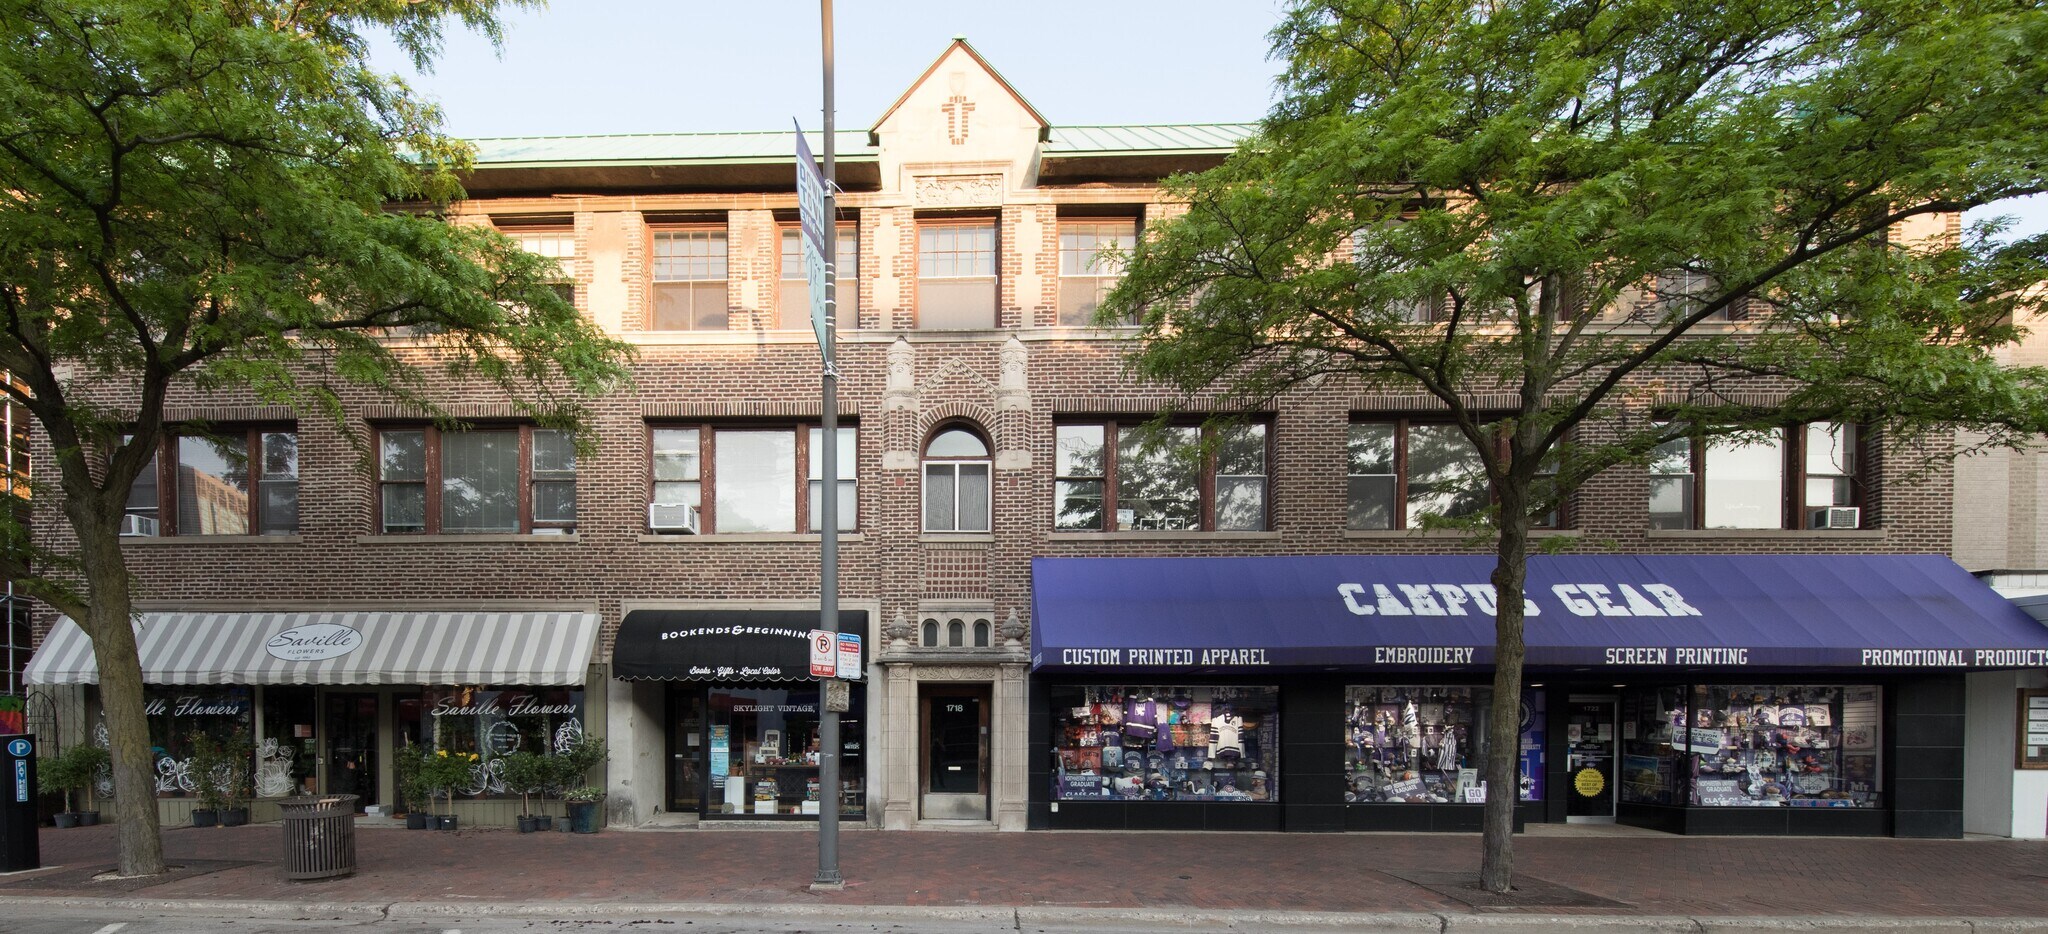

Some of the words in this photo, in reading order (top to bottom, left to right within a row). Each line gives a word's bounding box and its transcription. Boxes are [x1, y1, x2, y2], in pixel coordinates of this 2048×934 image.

[1551, 583, 1703, 617] GEAR
[267, 629, 353, 648] Saville
[661, 627, 730, 640] BOOKENDS
[1063, 648, 1120, 665] CUSTOM
[1128, 648, 1193, 665] PRINTED
[1201, 648, 1270, 665] APPAREL
[1374, 647, 1474, 664] EMBROIDERY
[1605, 648, 1667, 664] SCREEN
[1675, 648, 1748, 665] PRINTING
[1862, 649, 1967, 666] PROMOTIONAL
[1975, 649, 2048, 666] PRODUCT
[689, 666, 711, 675] Books
[717, 666, 735, 677] Gifts
[740, 666, 761, 676] Local
[762, 666, 781, 675] Color
[813, 664, 822, 672] TOW
[174, 696, 240, 717] Flowers
[431, 697, 500, 717] Saville
[508, 695, 577, 717] Flowers
[777, 705, 816, 713] VINTAGE,
[946, 704, 964, 712] 1718
[18, 778, 26, 800] HERE
[1468, 788, 1482, 798] GO
